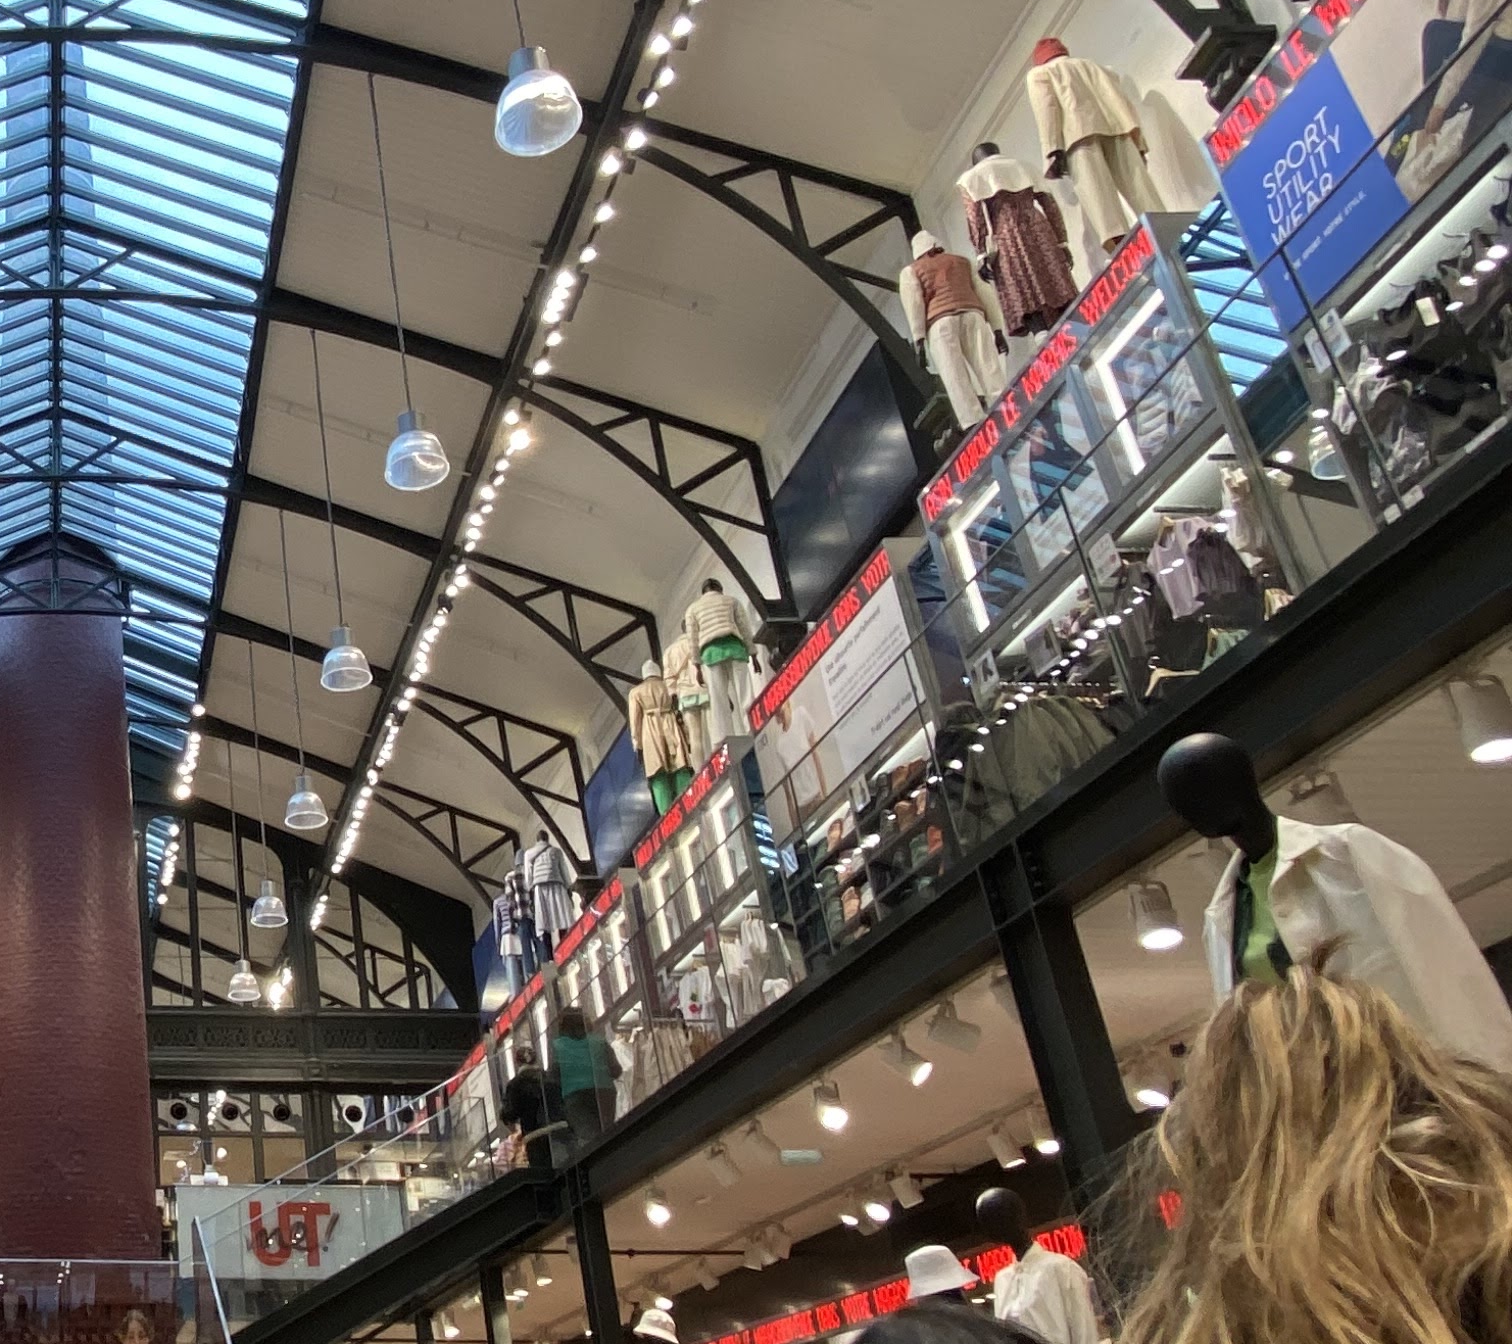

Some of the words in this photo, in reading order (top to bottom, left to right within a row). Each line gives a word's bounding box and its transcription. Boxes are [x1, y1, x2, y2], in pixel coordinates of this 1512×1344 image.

[1280, 29, 1315, 82] LE
[1262, 105, 1328, 199] SPORT
[1267, 123, 1341, 225] UTILITY
[1270, 172, 1333, 246] WEAR
[1000, 390, 1021, 430] LE
[1021, 323, 1078, 402] MARAIS
[248, 1200, 331, 1267] UT
